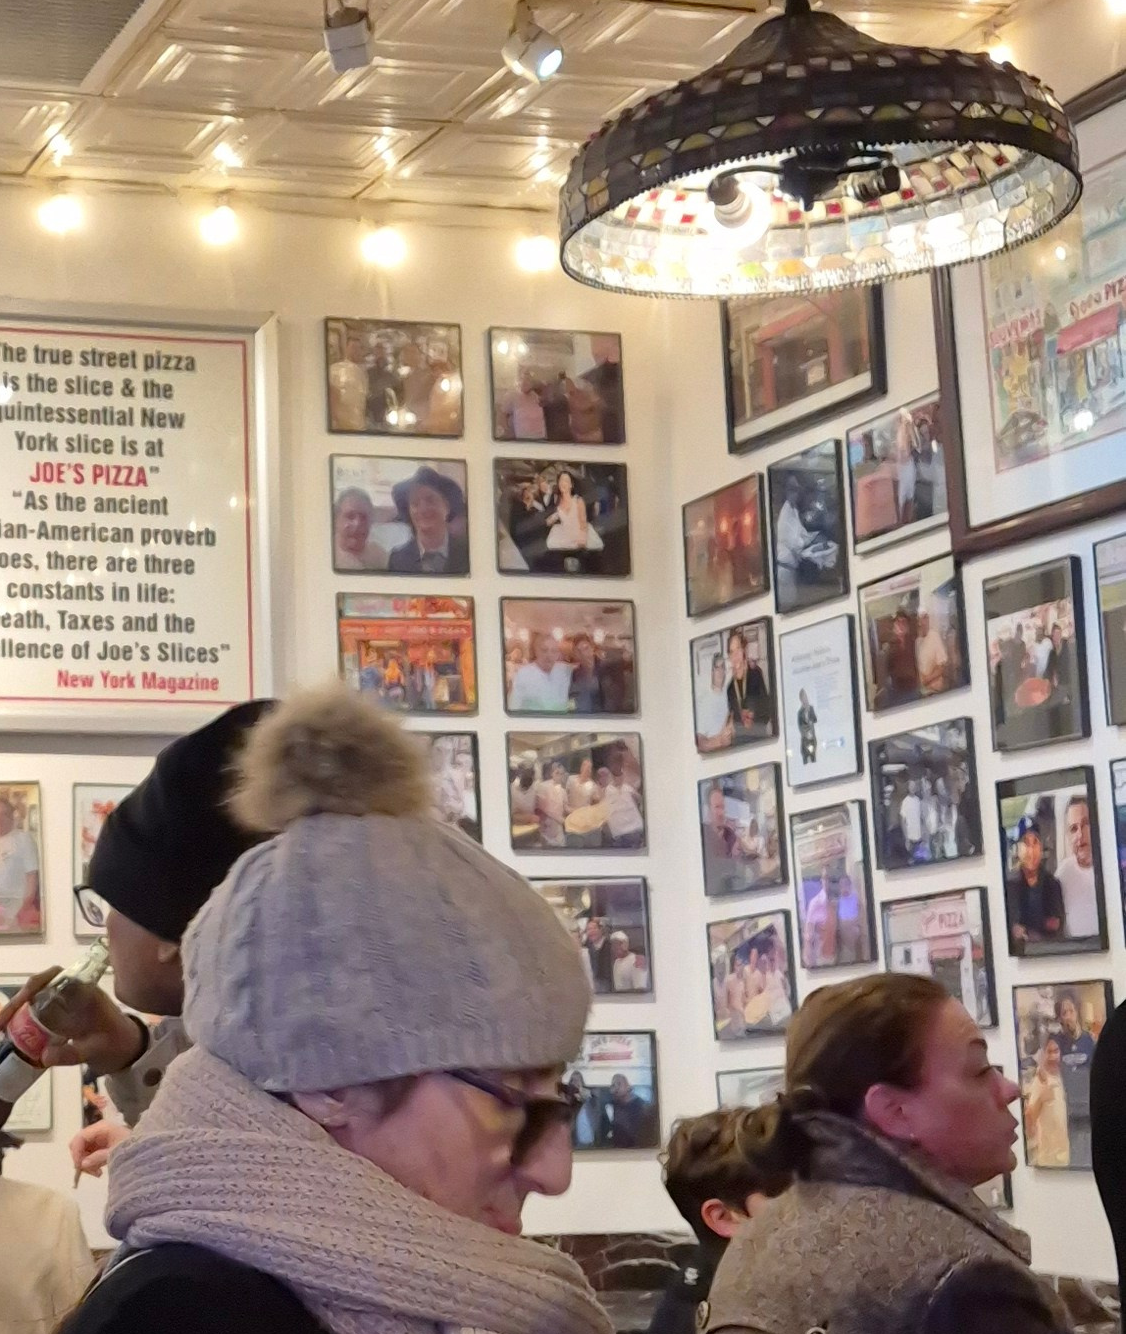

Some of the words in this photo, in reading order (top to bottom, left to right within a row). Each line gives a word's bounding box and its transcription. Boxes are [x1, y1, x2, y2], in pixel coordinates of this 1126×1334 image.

[33, 344, 72, 365] true
[80, 347, 137, 369] street
[143, 350, 196, 372] pizza
[2, 372, 20, 391] is
[27, 373, 57, 394] the
[65, 376, 113, 396] slice
[121, 378, 135, 398] &
[142, 379, 173, 400] the
[140, 407, 186, 429] New
[15, 431, 58, 452] York
[65, 434, 114, 455] slice
[121, 436, 138, 456] is
[145, 438, 164, 457] at
[30, 461, 84, 484] JOE'S
[55, 492, 86, 512] the
[93, 495, 169, 516] ancient
[140, 527, 216, 547] proverb
[46, 550, 98, 571] there
[105, 555, 137, 574] are
[144, 554, 195, 575] three
[6, 580, 104, 602] constants
[111, 582, 130, 602] in
[136, 582, 175, 604] life:
[57, 610, 114, 632] Taxes
[122, 613, 158, 633] and
[164, 613, 195, 634] the
[71, 640, 90, 660] of
[96, 641, 150, 662] Joe's
[57, 669, 94, 689] New
[100, 669, 135, 690] York
[142, 671, 219, 694] Magazine
